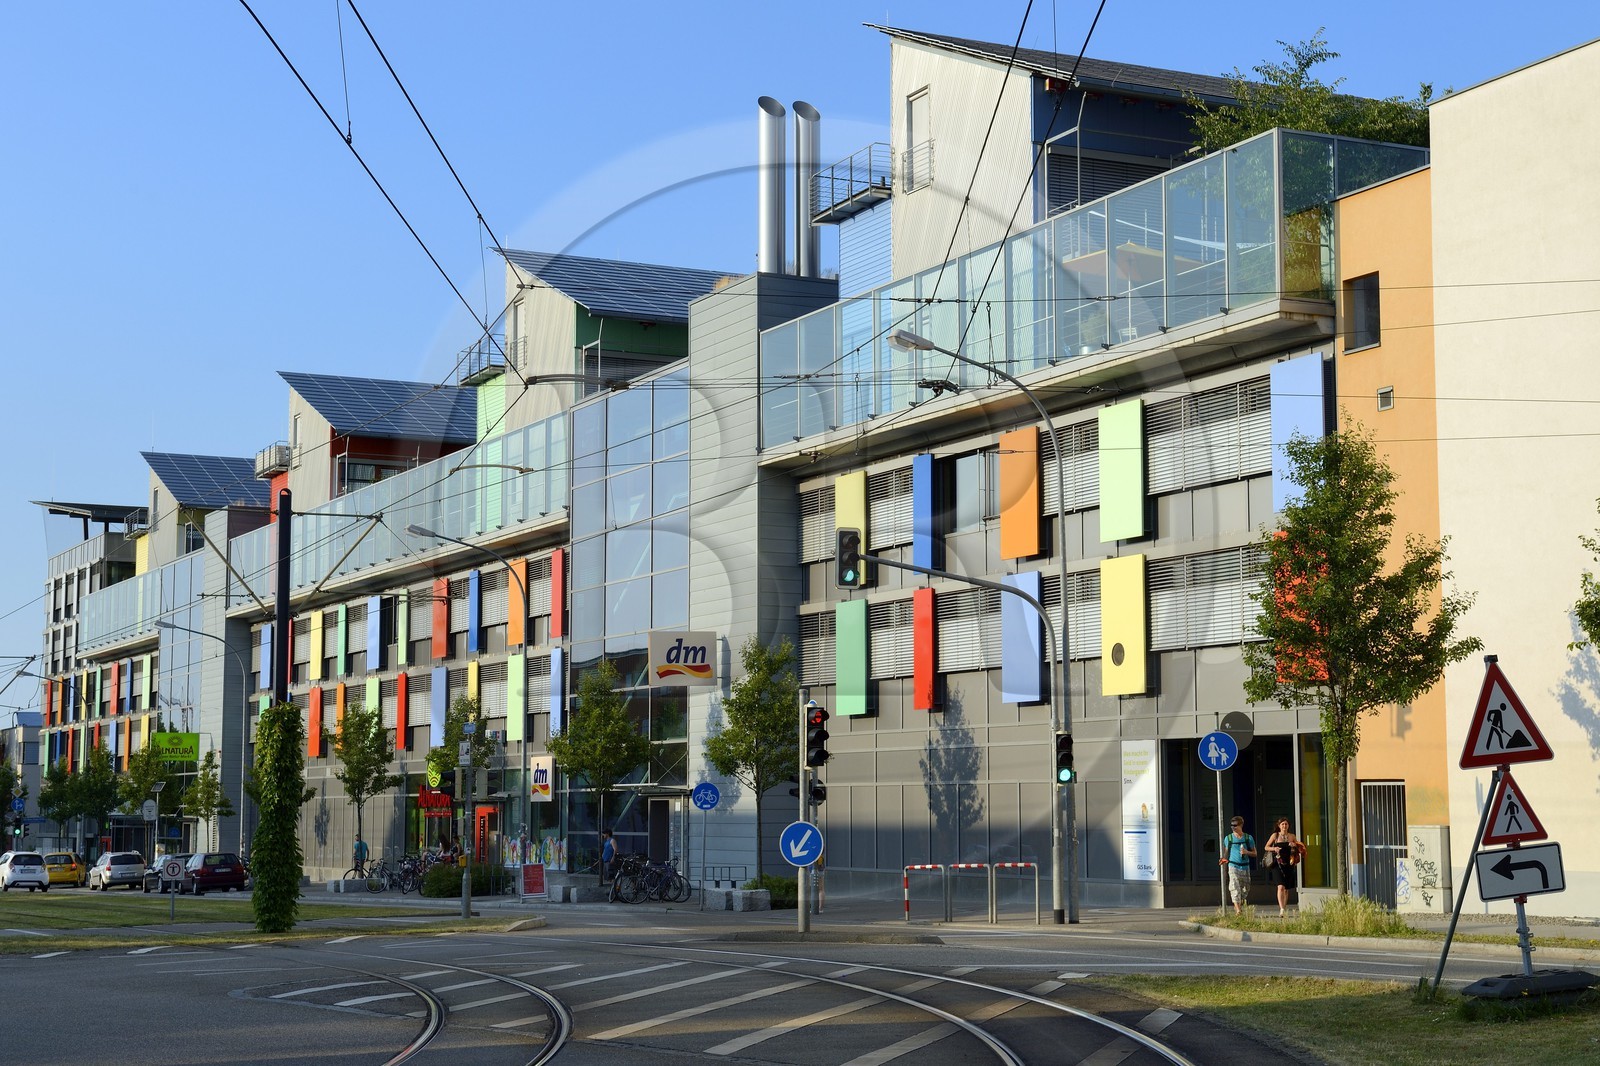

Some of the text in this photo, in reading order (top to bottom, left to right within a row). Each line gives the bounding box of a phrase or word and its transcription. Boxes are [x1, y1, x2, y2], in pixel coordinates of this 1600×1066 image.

[666, 638, 706, 664] dm
[158, 745, 194, 755] LNATURA
[534, 763, 548, 784] dm
